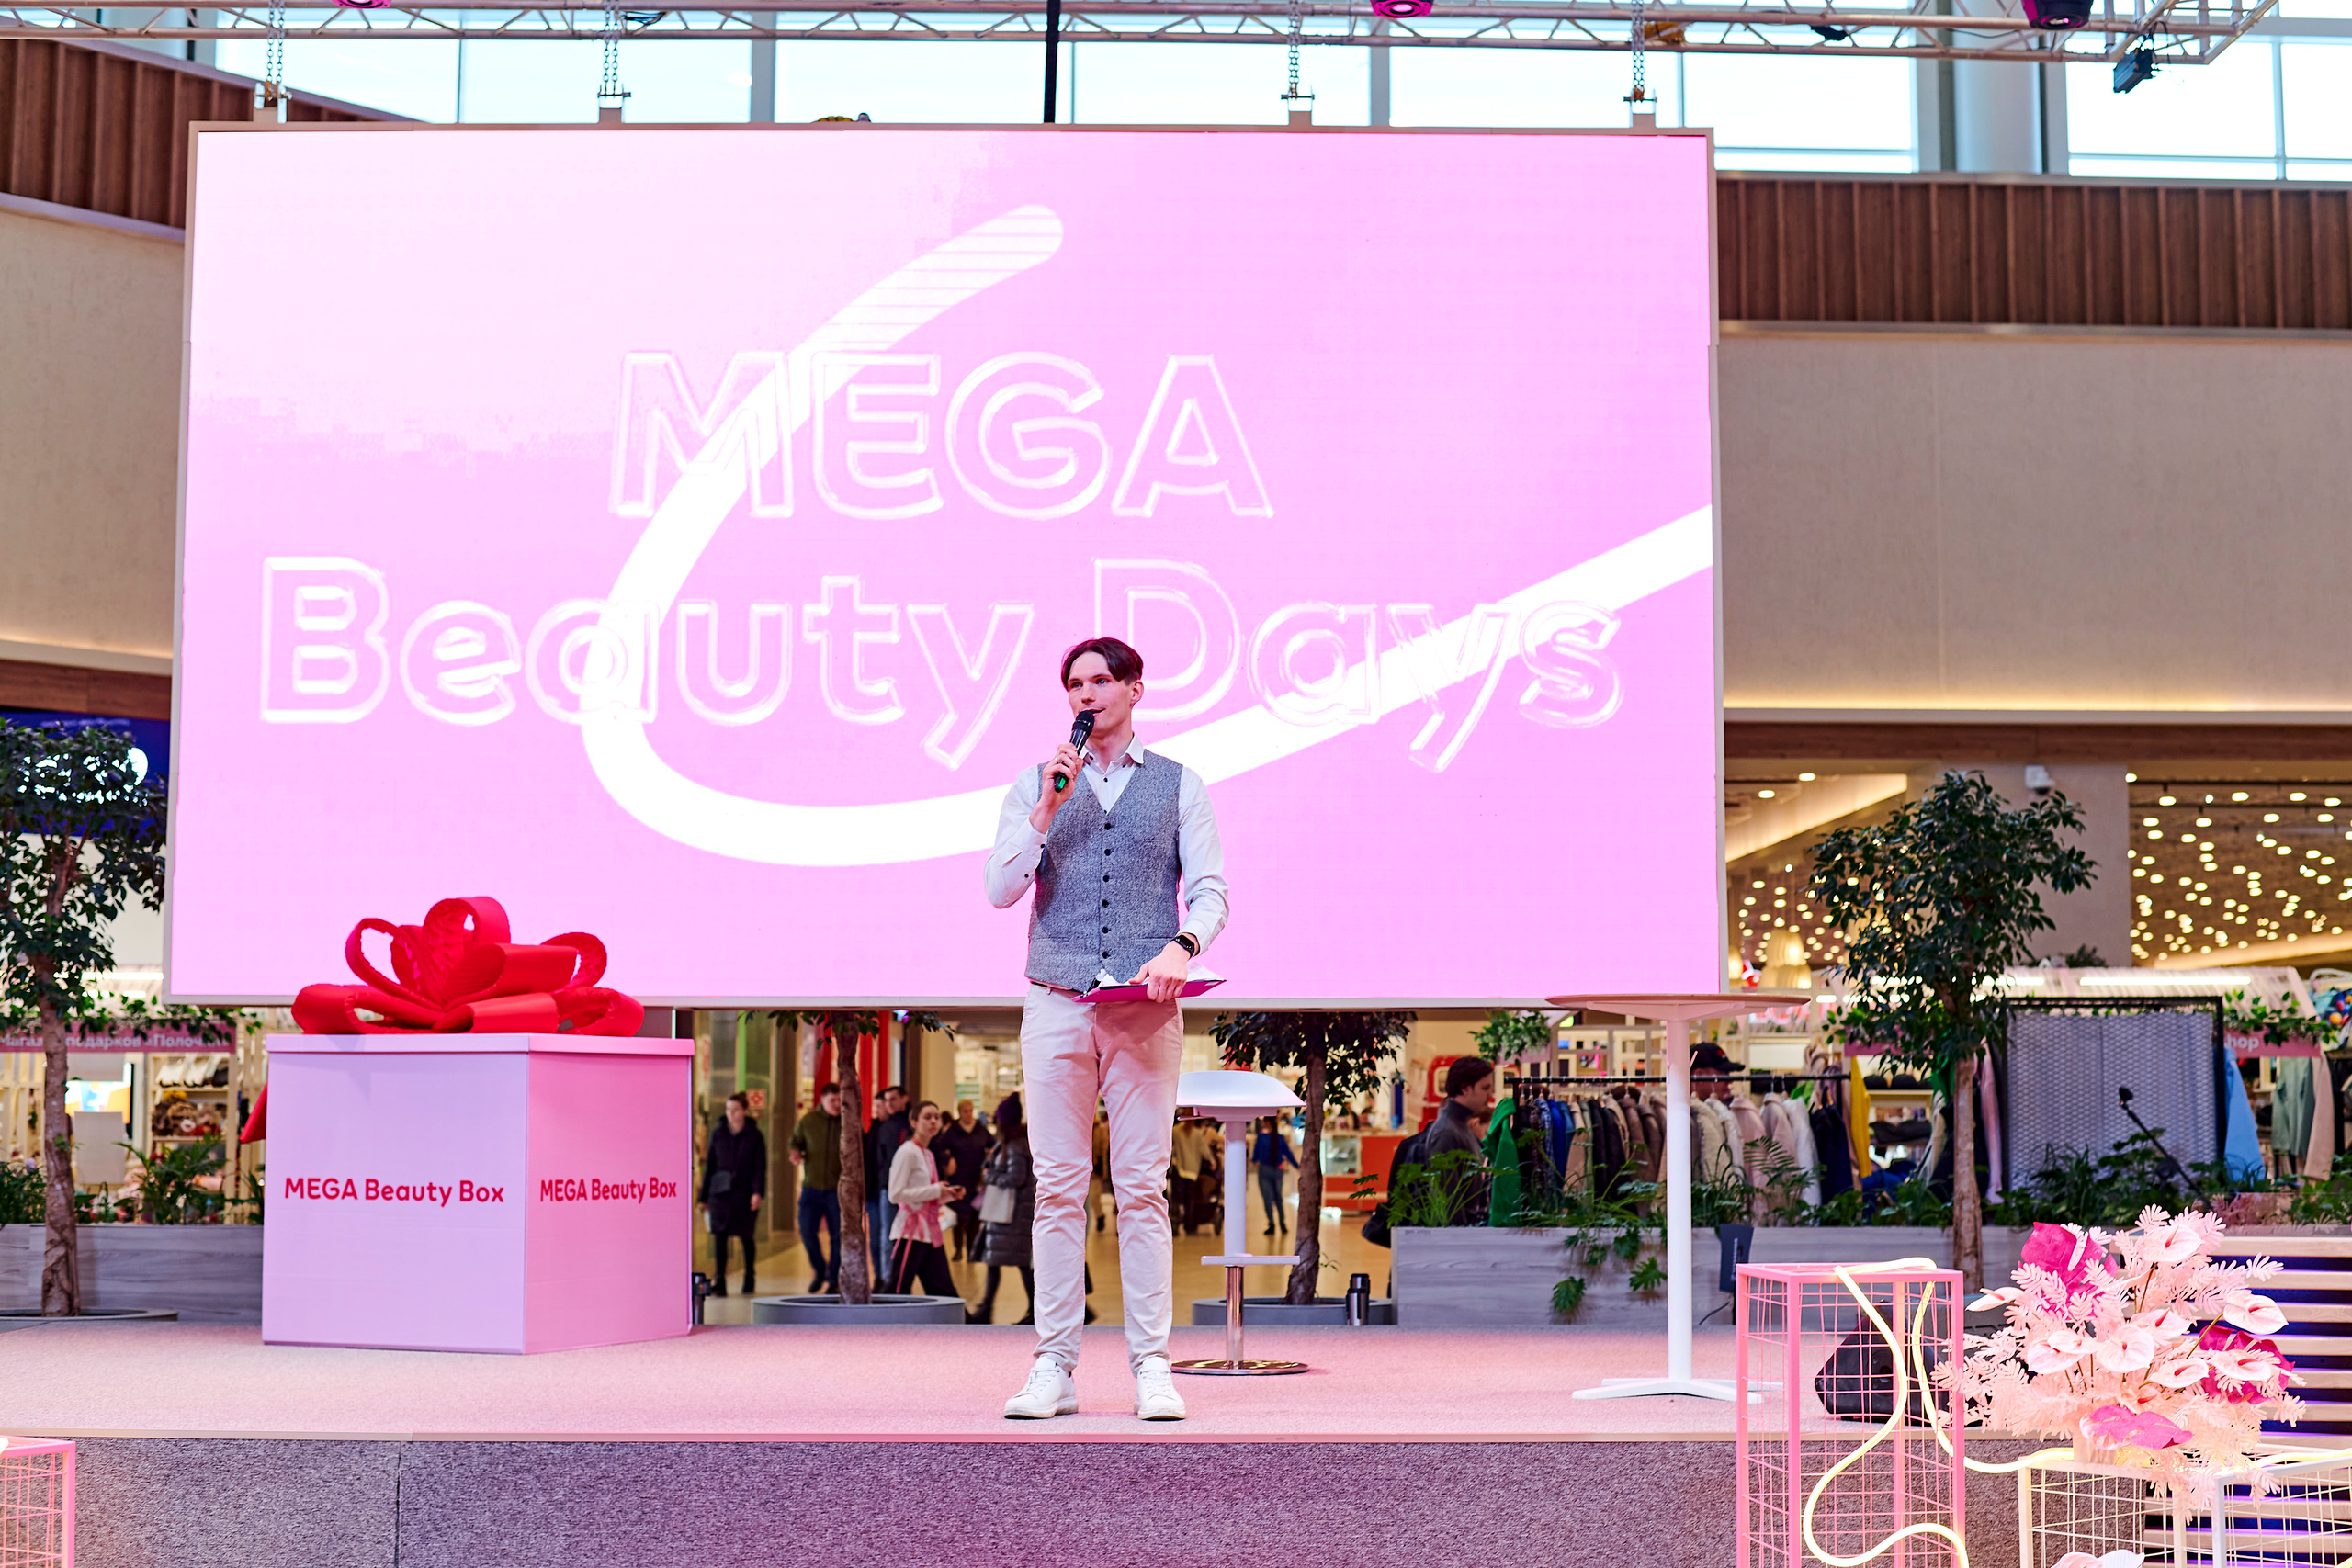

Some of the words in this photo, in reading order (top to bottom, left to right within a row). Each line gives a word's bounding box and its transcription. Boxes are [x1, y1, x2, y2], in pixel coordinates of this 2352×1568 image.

[608, 350, 1275, 520] MEGA
[260, 555, 1035, 770] Beauty
[1091, 557, 1624, 773] Days
[284, 1177, 358, 1200] MEGA
[365, 1179, 453, 1207] Beauty
[459, 1179, 504, 1202] Box
[540, 1179, 588, 1202] MEGA
[591, 1178, 646, 1204] Beauty
[649, 1176, 677, 1199] Box
